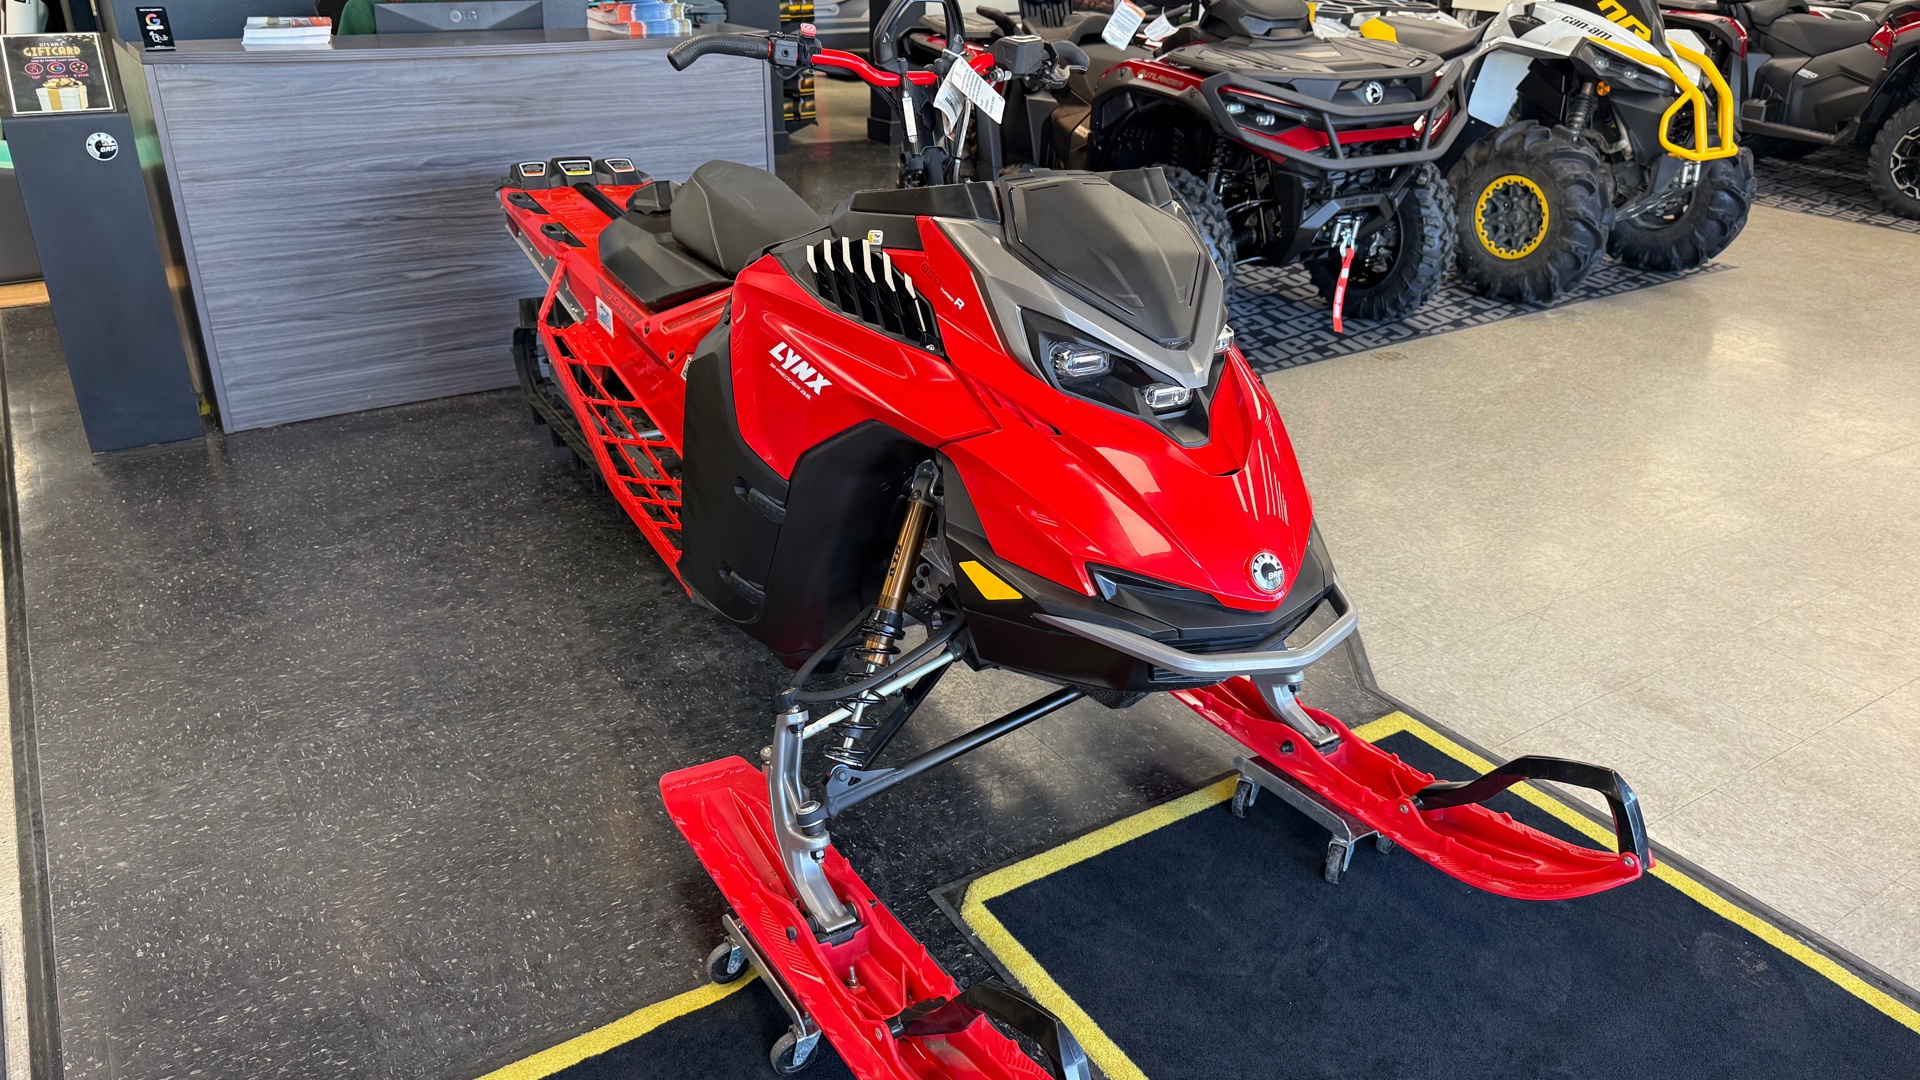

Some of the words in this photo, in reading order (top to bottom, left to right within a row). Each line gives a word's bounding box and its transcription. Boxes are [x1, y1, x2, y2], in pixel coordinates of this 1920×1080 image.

[463, 10, 478, 21] LG
[1561, 15, 1612, 41] can-am
[22, 45, 81, 57] GIFTCARD
[1136, 69, 1185, 88] OUTLANDER
[920, 261, 943, 287] 850
[940, 286, 955, 302] TURBO
[953, 297, 966, 310] R
[605, 290, 637, 321] 3900
[768, 341, 833, 396] LYNX
[1267, 570, 1283, 580] BRP
